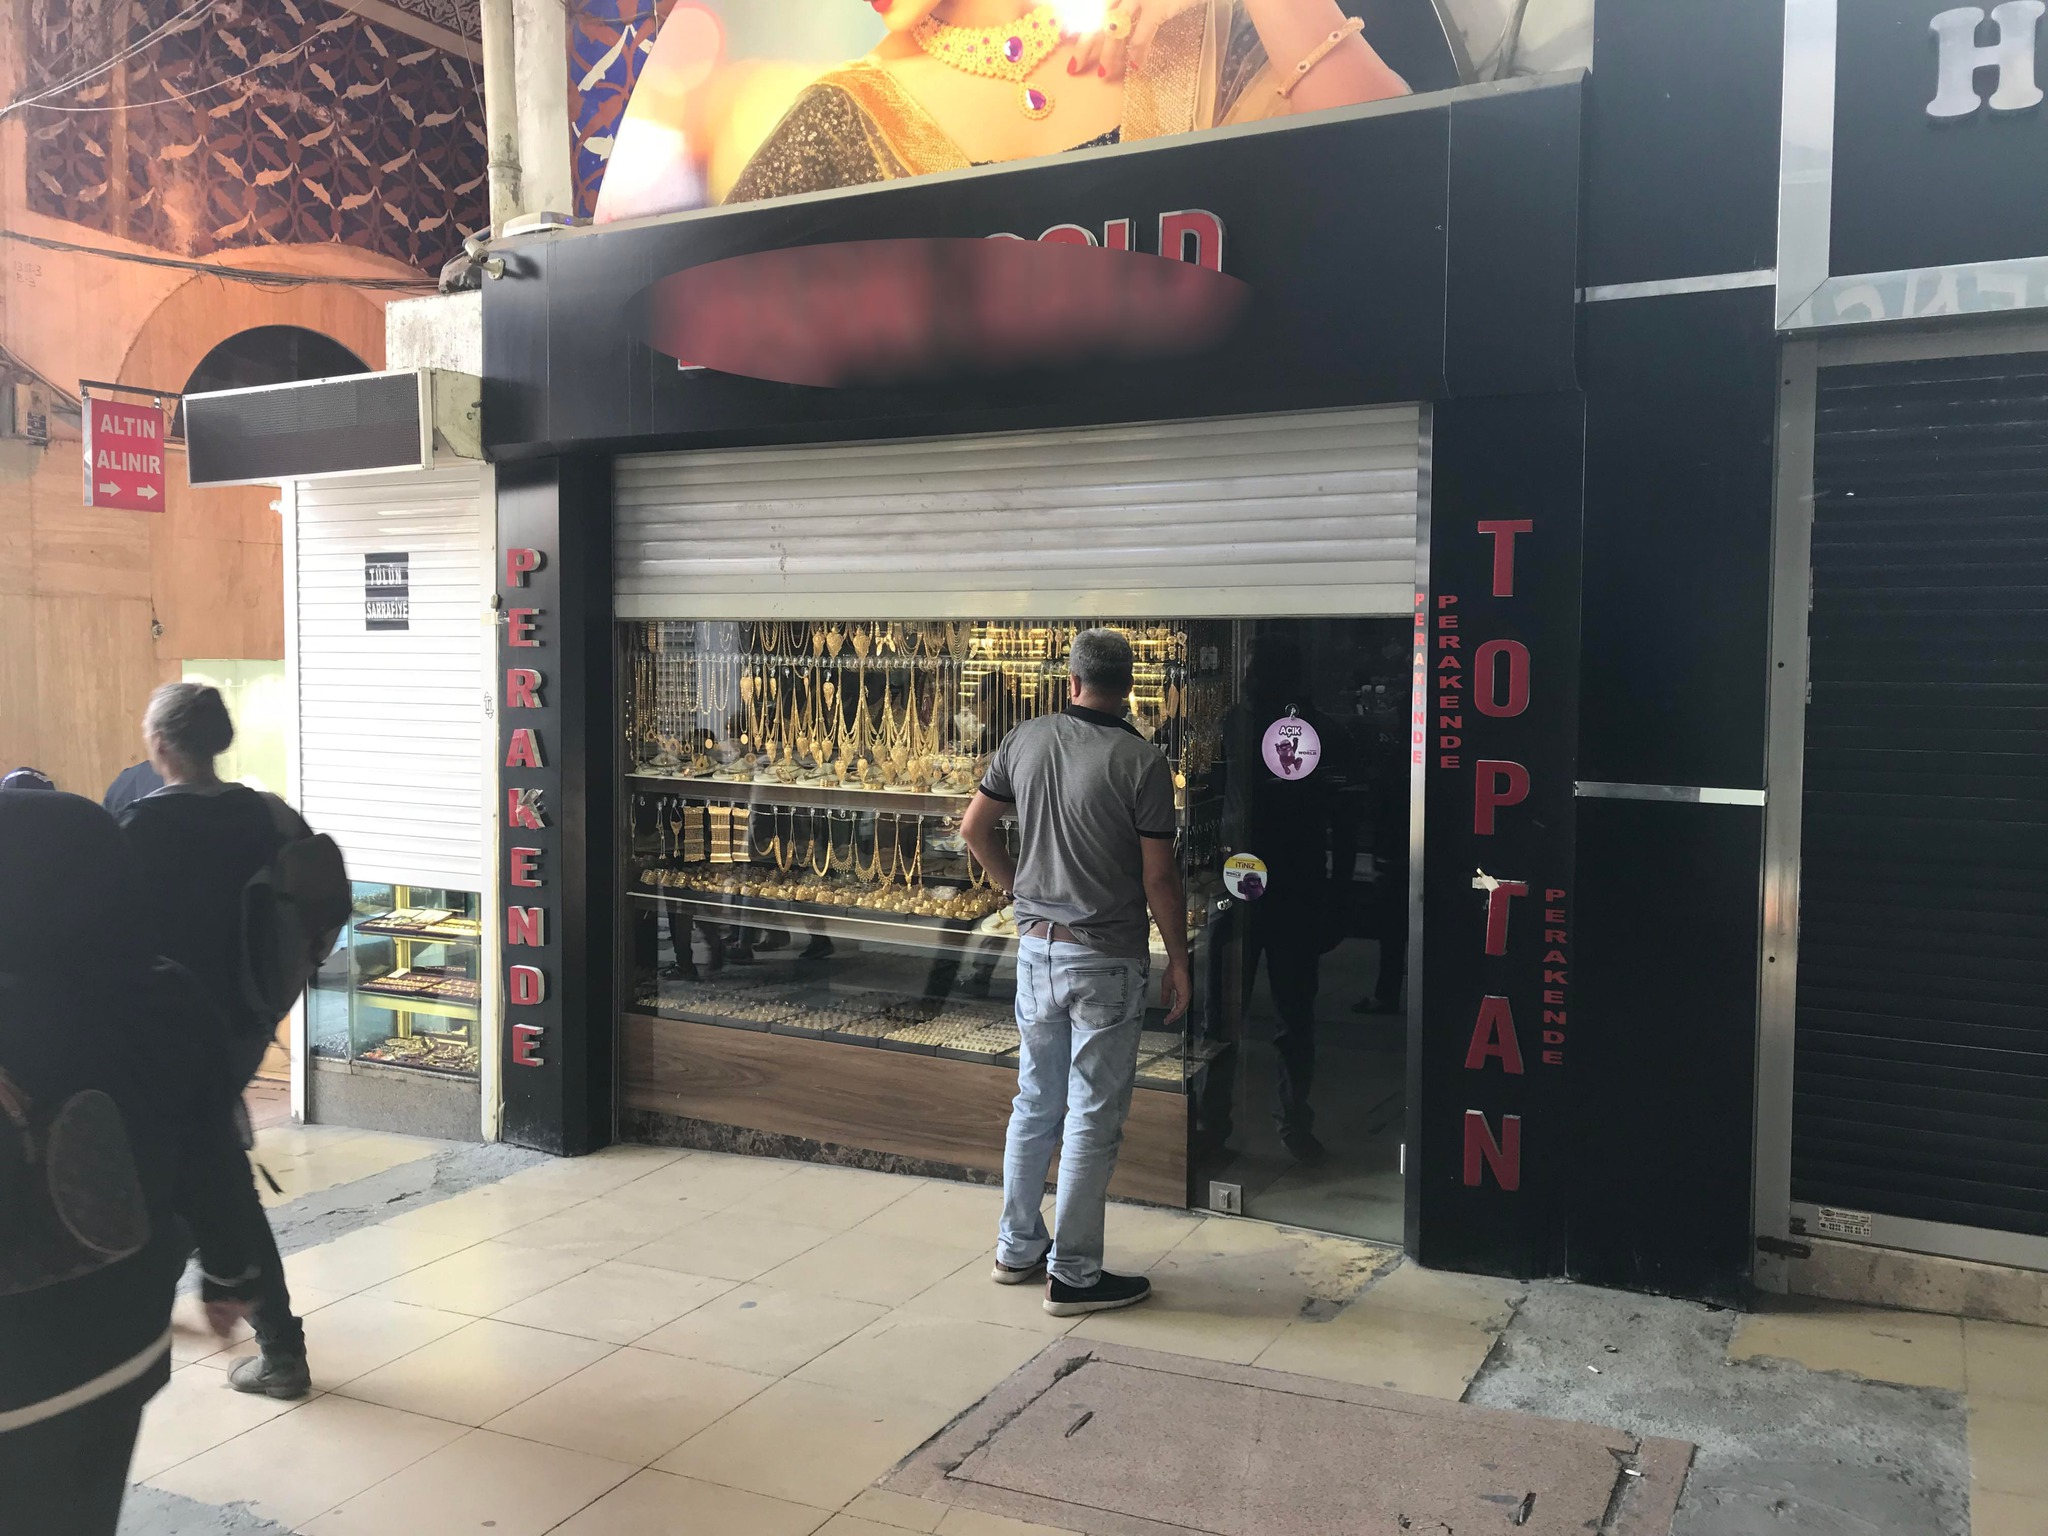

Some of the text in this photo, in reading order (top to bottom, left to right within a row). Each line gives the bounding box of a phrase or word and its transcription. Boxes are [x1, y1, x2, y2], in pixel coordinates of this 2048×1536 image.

[97, 449, 161, 475] ALINIR
[100, 413, 156, 439] ALTIN
[1279, 725, 1302, 738] AÇIK
[1412, 593, 1425, 764] PERAKENDE
[1438, 595, 1463, 769] PERAKENDE
[505, 548, 545, 1067] PERAKENDE
[1463, 519, 1534, 1191] TOPTAN
[1542, 888, 1568, 1065] PERAKENDE
